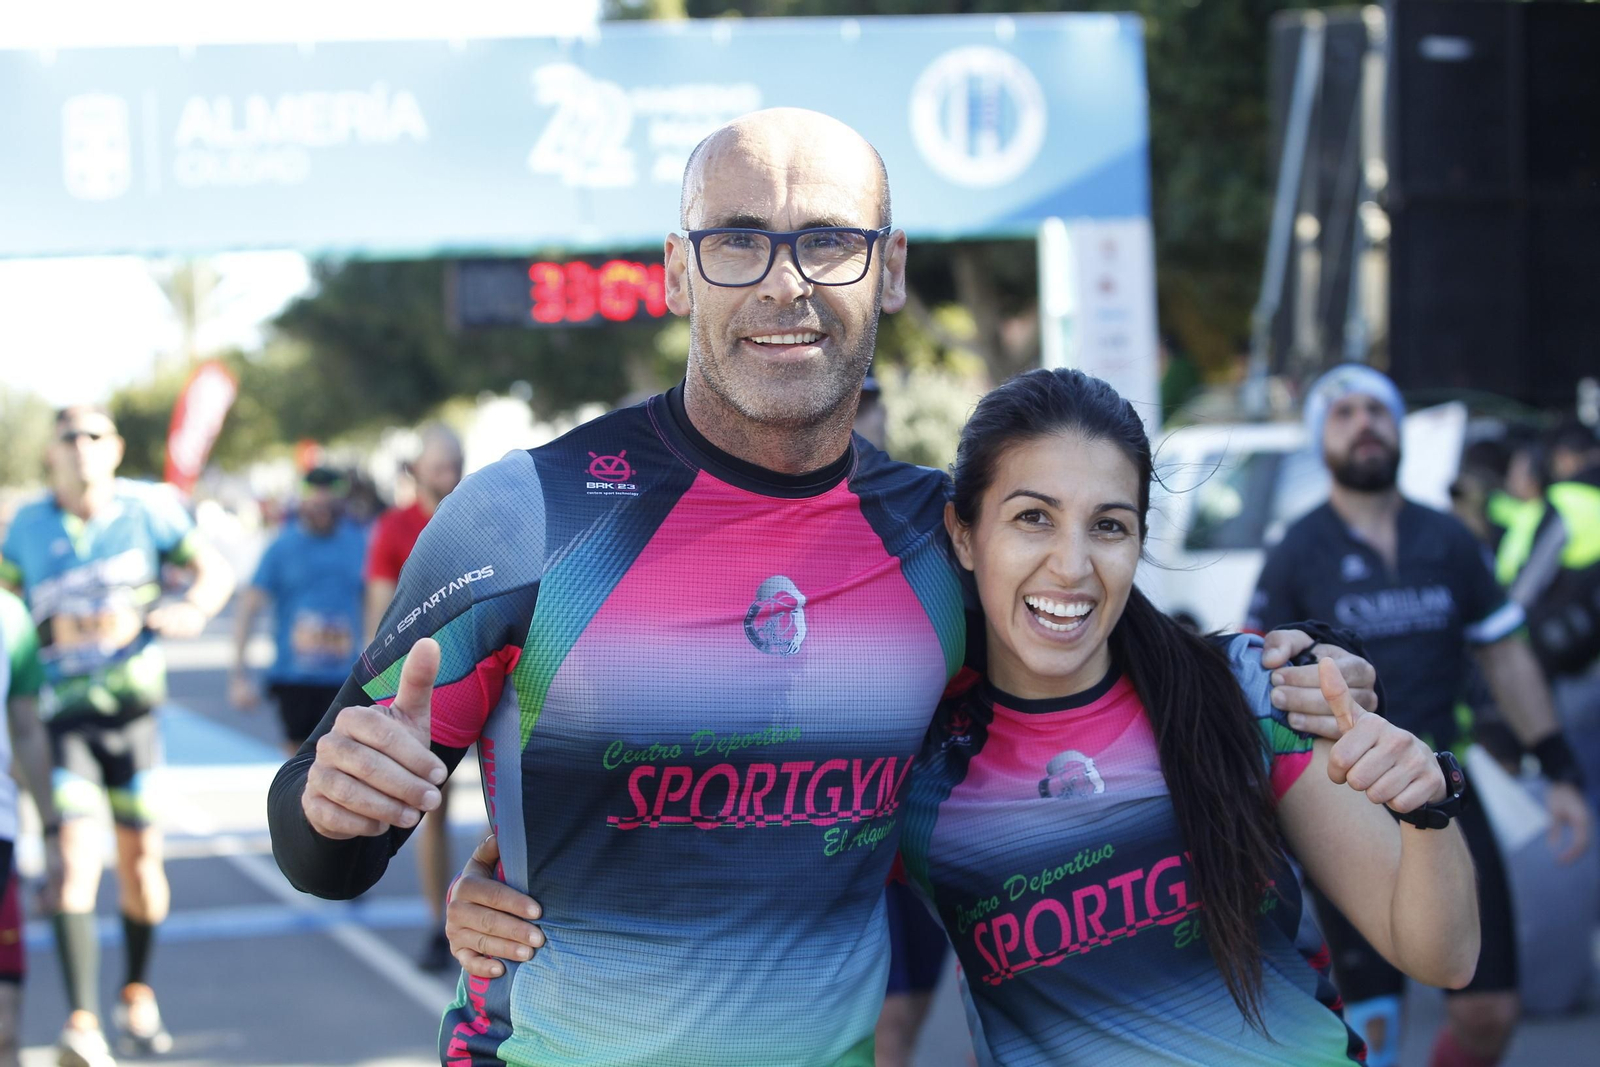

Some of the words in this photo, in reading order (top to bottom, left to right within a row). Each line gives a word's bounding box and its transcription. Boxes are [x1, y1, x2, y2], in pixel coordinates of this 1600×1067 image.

[586, 481, 615, 490] BRK
[397, 564, 494, 634] ESPARTANOS
[602, 739, 683, 770] Centro
[690, 724, 801, 758] Deportivo
[823, 827, 849, 856] El
[1003, 843, 1115, 902] Deportivo
[974, 851, 1194, 986] SPORTG
[1173, 919, 1201, 949] El
